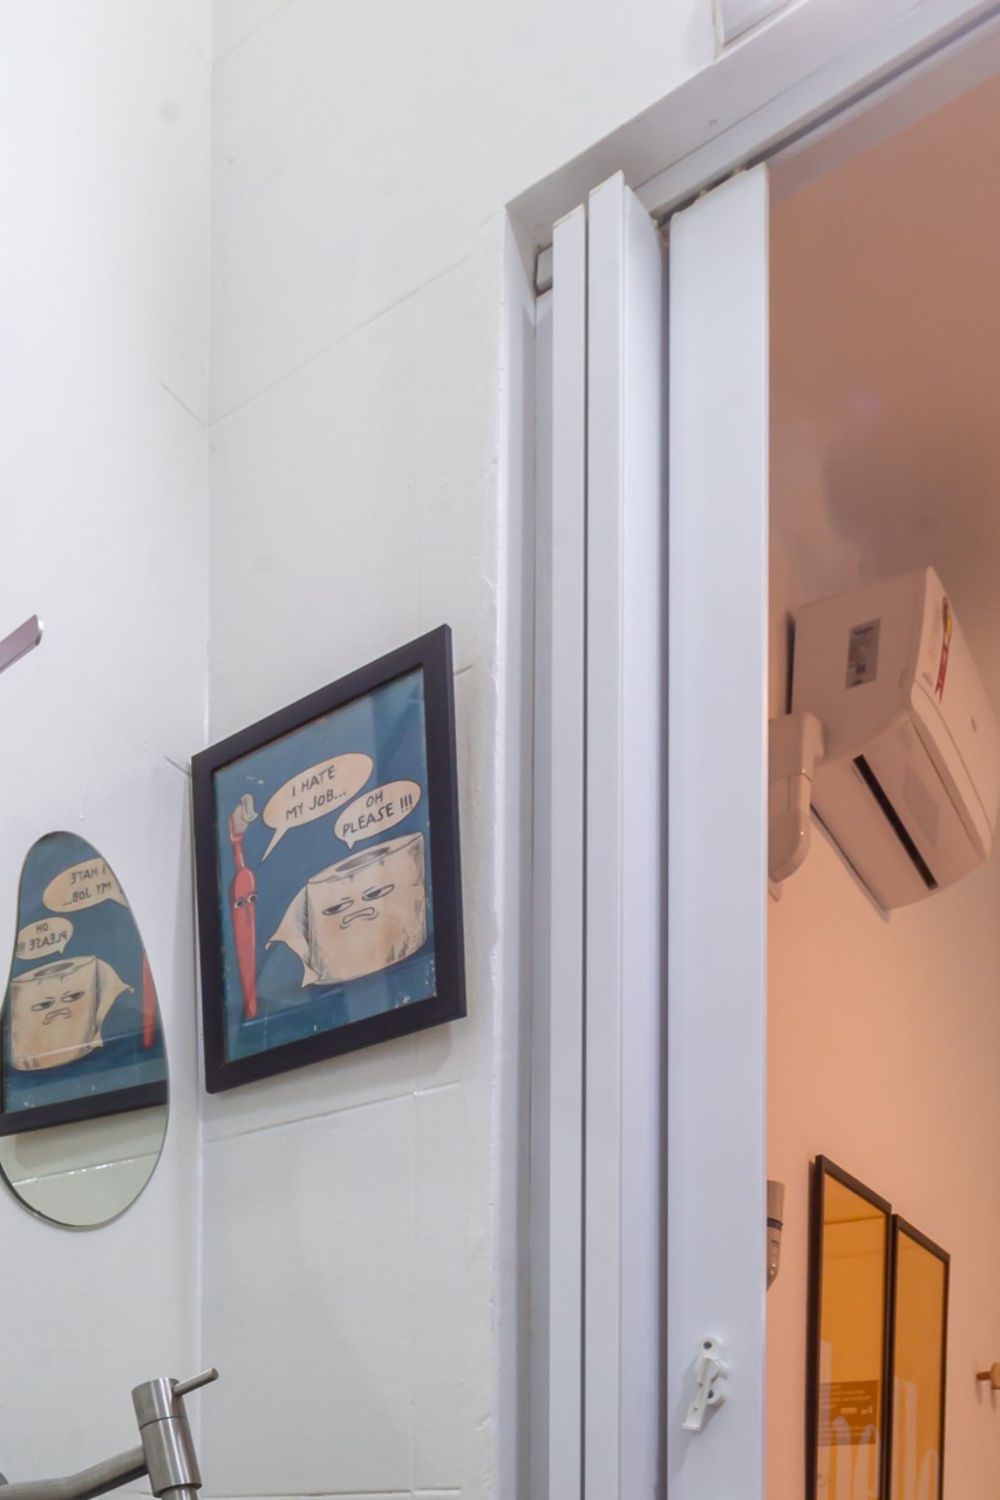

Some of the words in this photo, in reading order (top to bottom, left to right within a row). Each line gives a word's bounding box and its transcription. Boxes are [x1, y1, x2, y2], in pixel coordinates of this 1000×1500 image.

[300, 764, 336, 793] HATE
[285, 802, 304, 821] MY
[308, 788, 347, 810] JOB...
[365, 790, 384, 808] OH
[342, 802, 395, 838] PLEASE
